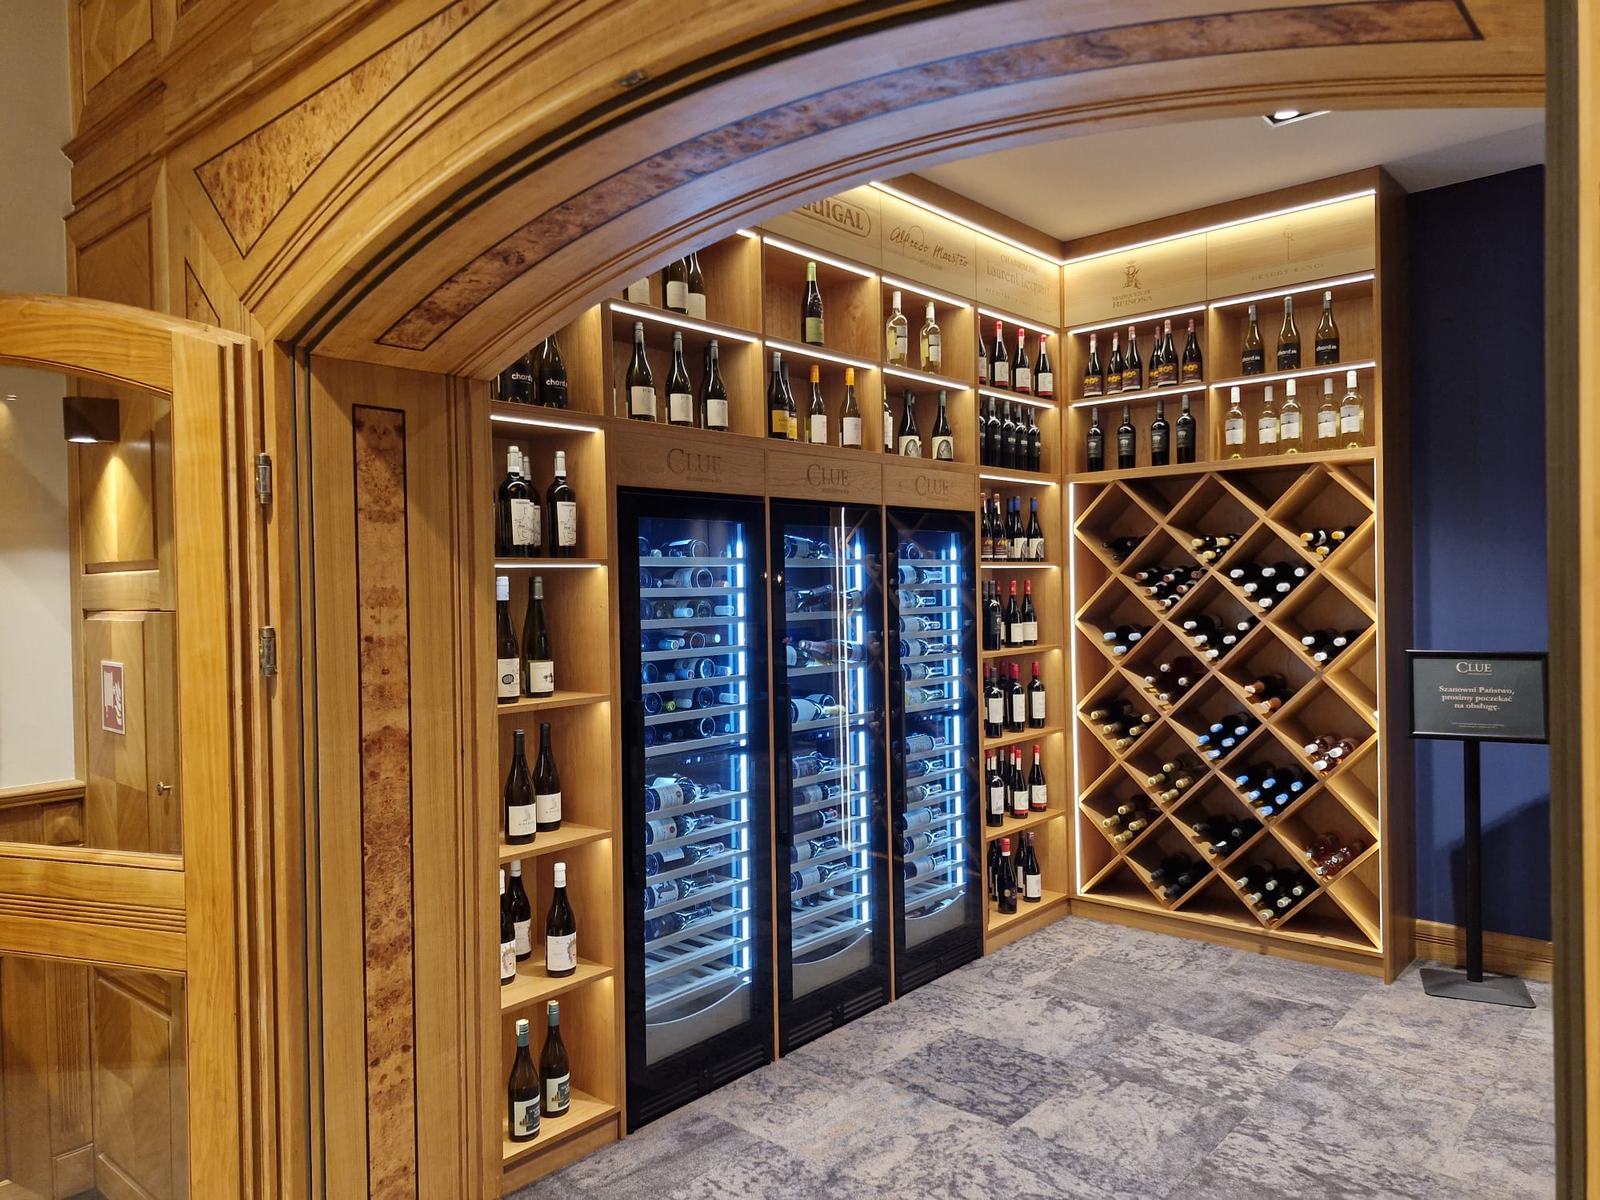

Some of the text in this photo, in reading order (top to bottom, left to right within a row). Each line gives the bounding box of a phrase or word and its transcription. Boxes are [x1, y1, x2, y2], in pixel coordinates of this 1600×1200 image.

[889, 226, 929, 254] Alfredo
[932, 243, 969, 267] Maestro
[806, 463, 851, 488] CLUE
[914, 474, 949, 497] CLUE
[1455, 661, 1493, 673] CLUE
[1438, 685, 1477, 693] Szanowni
[1441, 694, 1513, 703] prosimy poczekać
